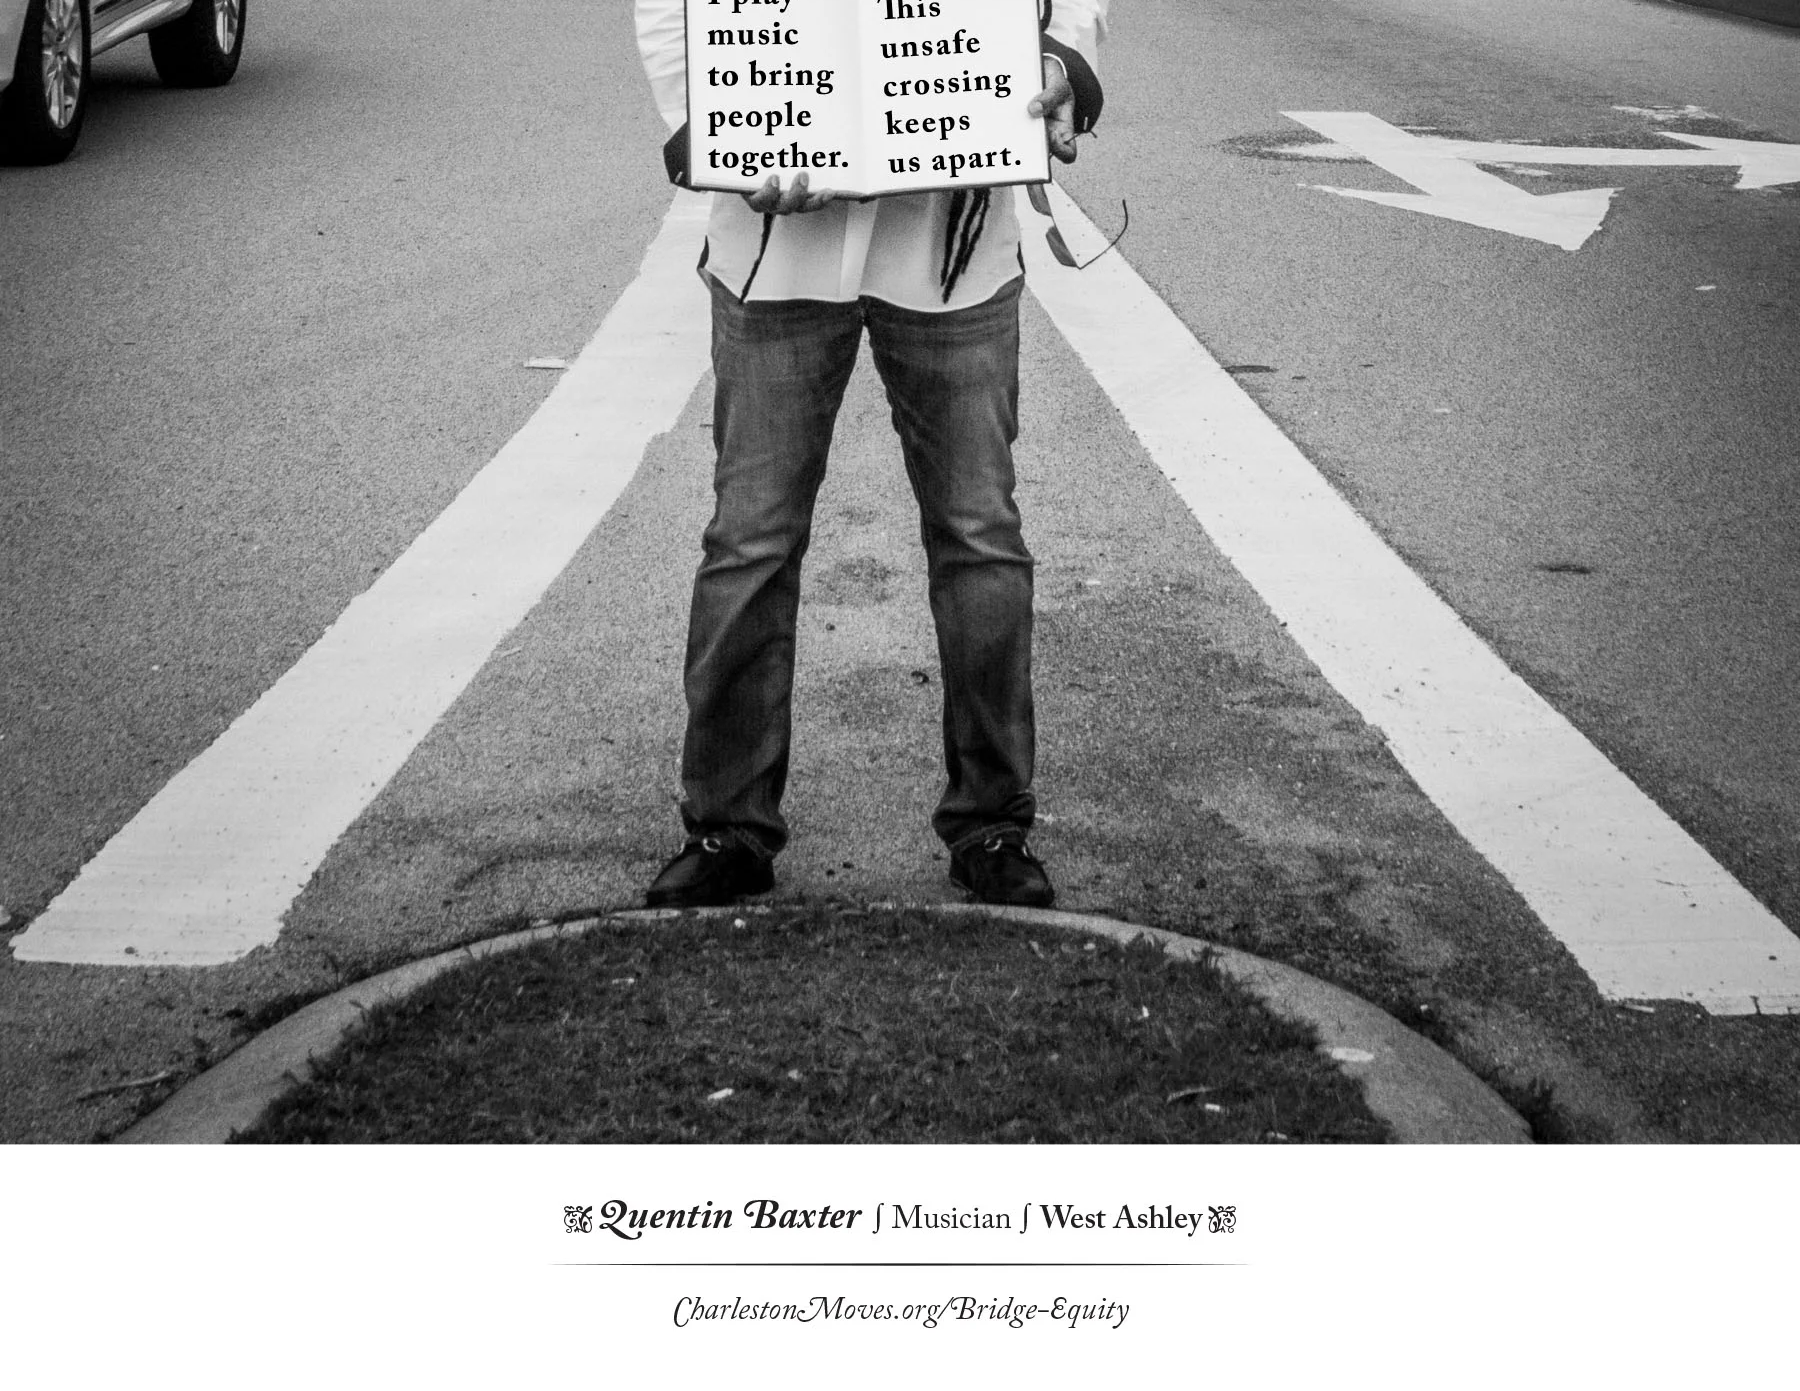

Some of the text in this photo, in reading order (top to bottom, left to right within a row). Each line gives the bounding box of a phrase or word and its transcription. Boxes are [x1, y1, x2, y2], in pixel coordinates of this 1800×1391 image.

[707, 21, 799, 46] music
[880, 28, 981, 59] unsafe
[707, 59, 835, 95] to bring
[883, 69, 1012, 99] crossing
[707, 100, 812, 137] people
[884, 110, 971, 141] keeps
[707, 141, 849, 177] together.
[887, 147, 1021, 178] us apart.
